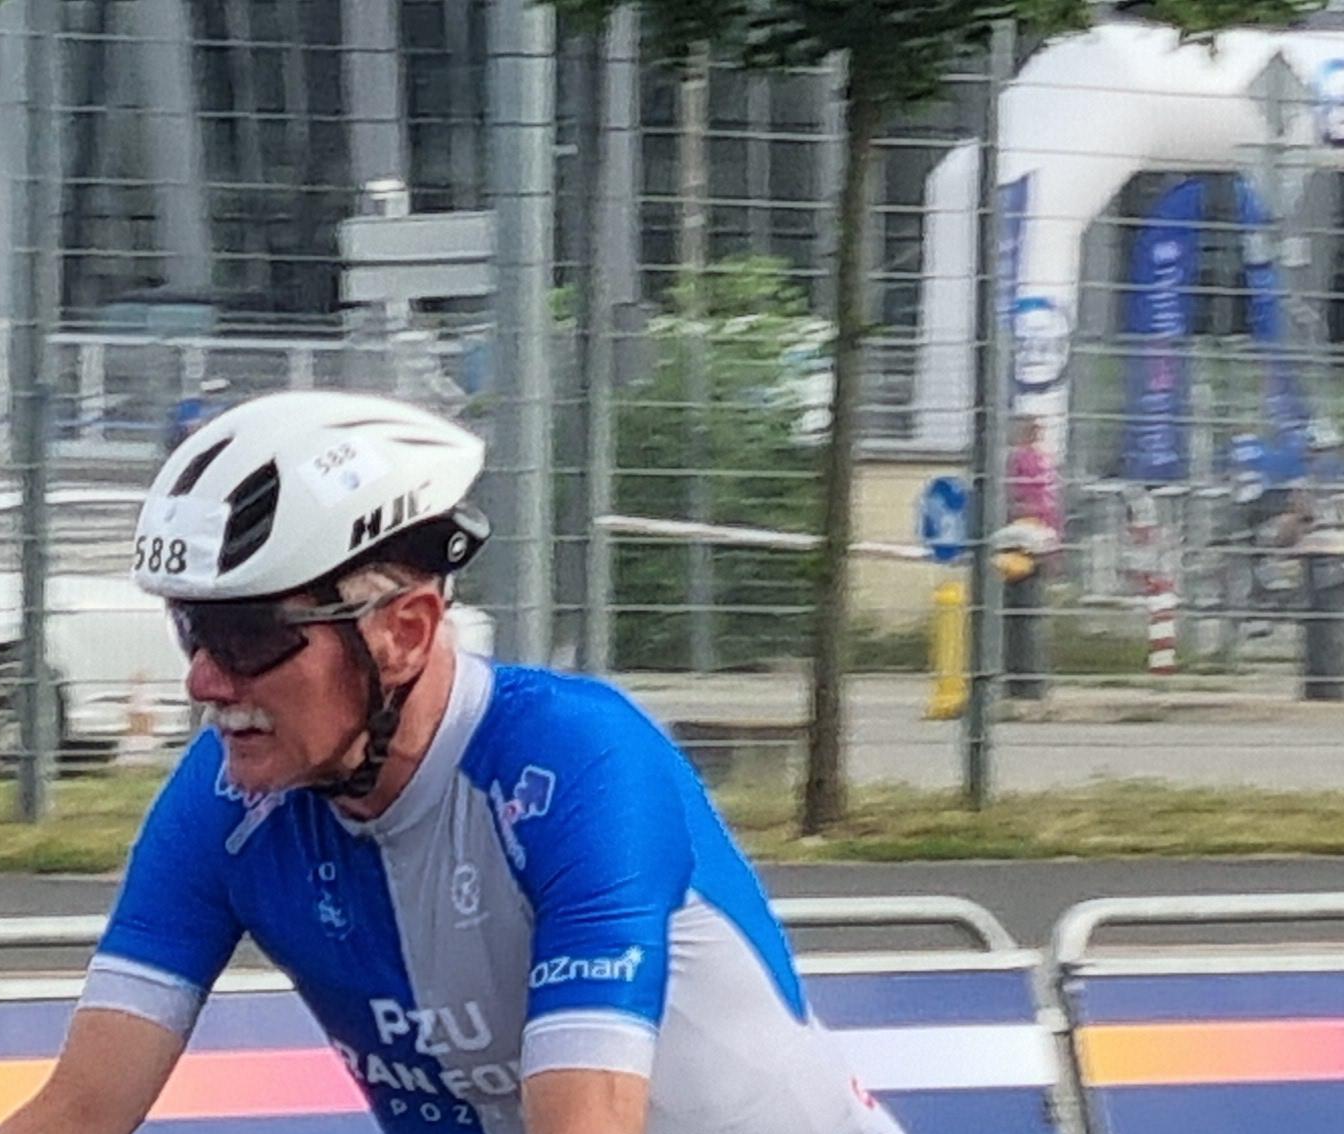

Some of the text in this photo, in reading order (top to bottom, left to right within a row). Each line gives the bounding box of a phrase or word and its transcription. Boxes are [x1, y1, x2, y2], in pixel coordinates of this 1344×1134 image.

[313, 442, 358, 476] 588
[133, 535, 188, 575] 588
[369, 998, 493, 1056] PZU
[390, 1098, 482, 1125] POZ
